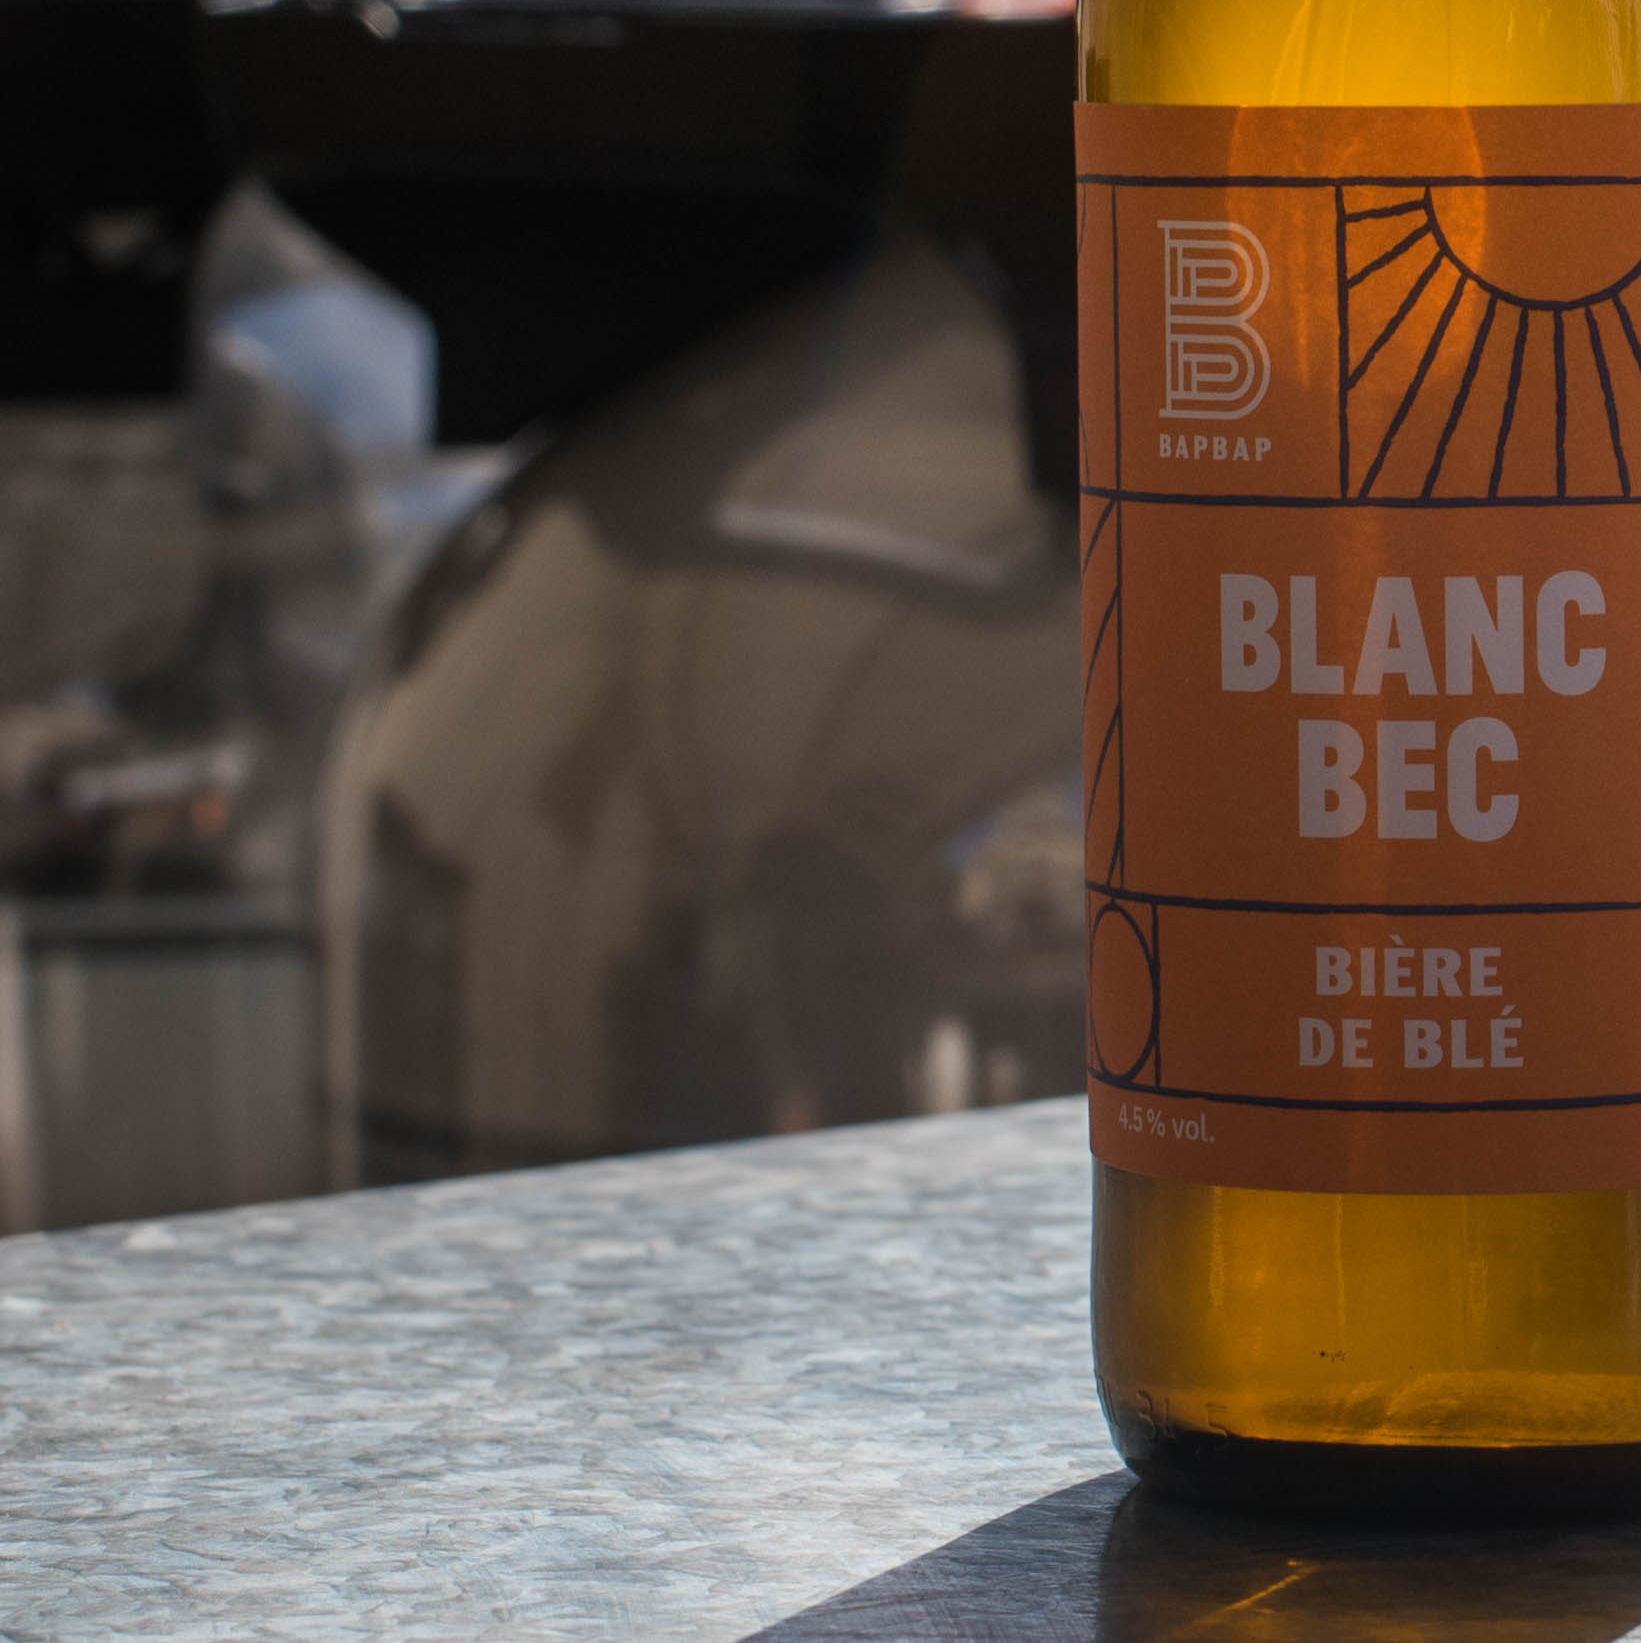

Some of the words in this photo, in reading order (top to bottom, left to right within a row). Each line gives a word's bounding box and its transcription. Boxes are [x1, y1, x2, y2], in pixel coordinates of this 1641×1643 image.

[1159, 432, 1272, 462] BAPBAP
[1219, 570, 1607, 697] BLANC
[1297, 717, 1520, 842] BEC
[1315, 933, 1504, 997] BIÈRE
[1298, 1016, 1374, 1069] DE
[1403, 1004, 1525, 1070] BLÉ
[1171, 1112, 1216, 1143] vol.
